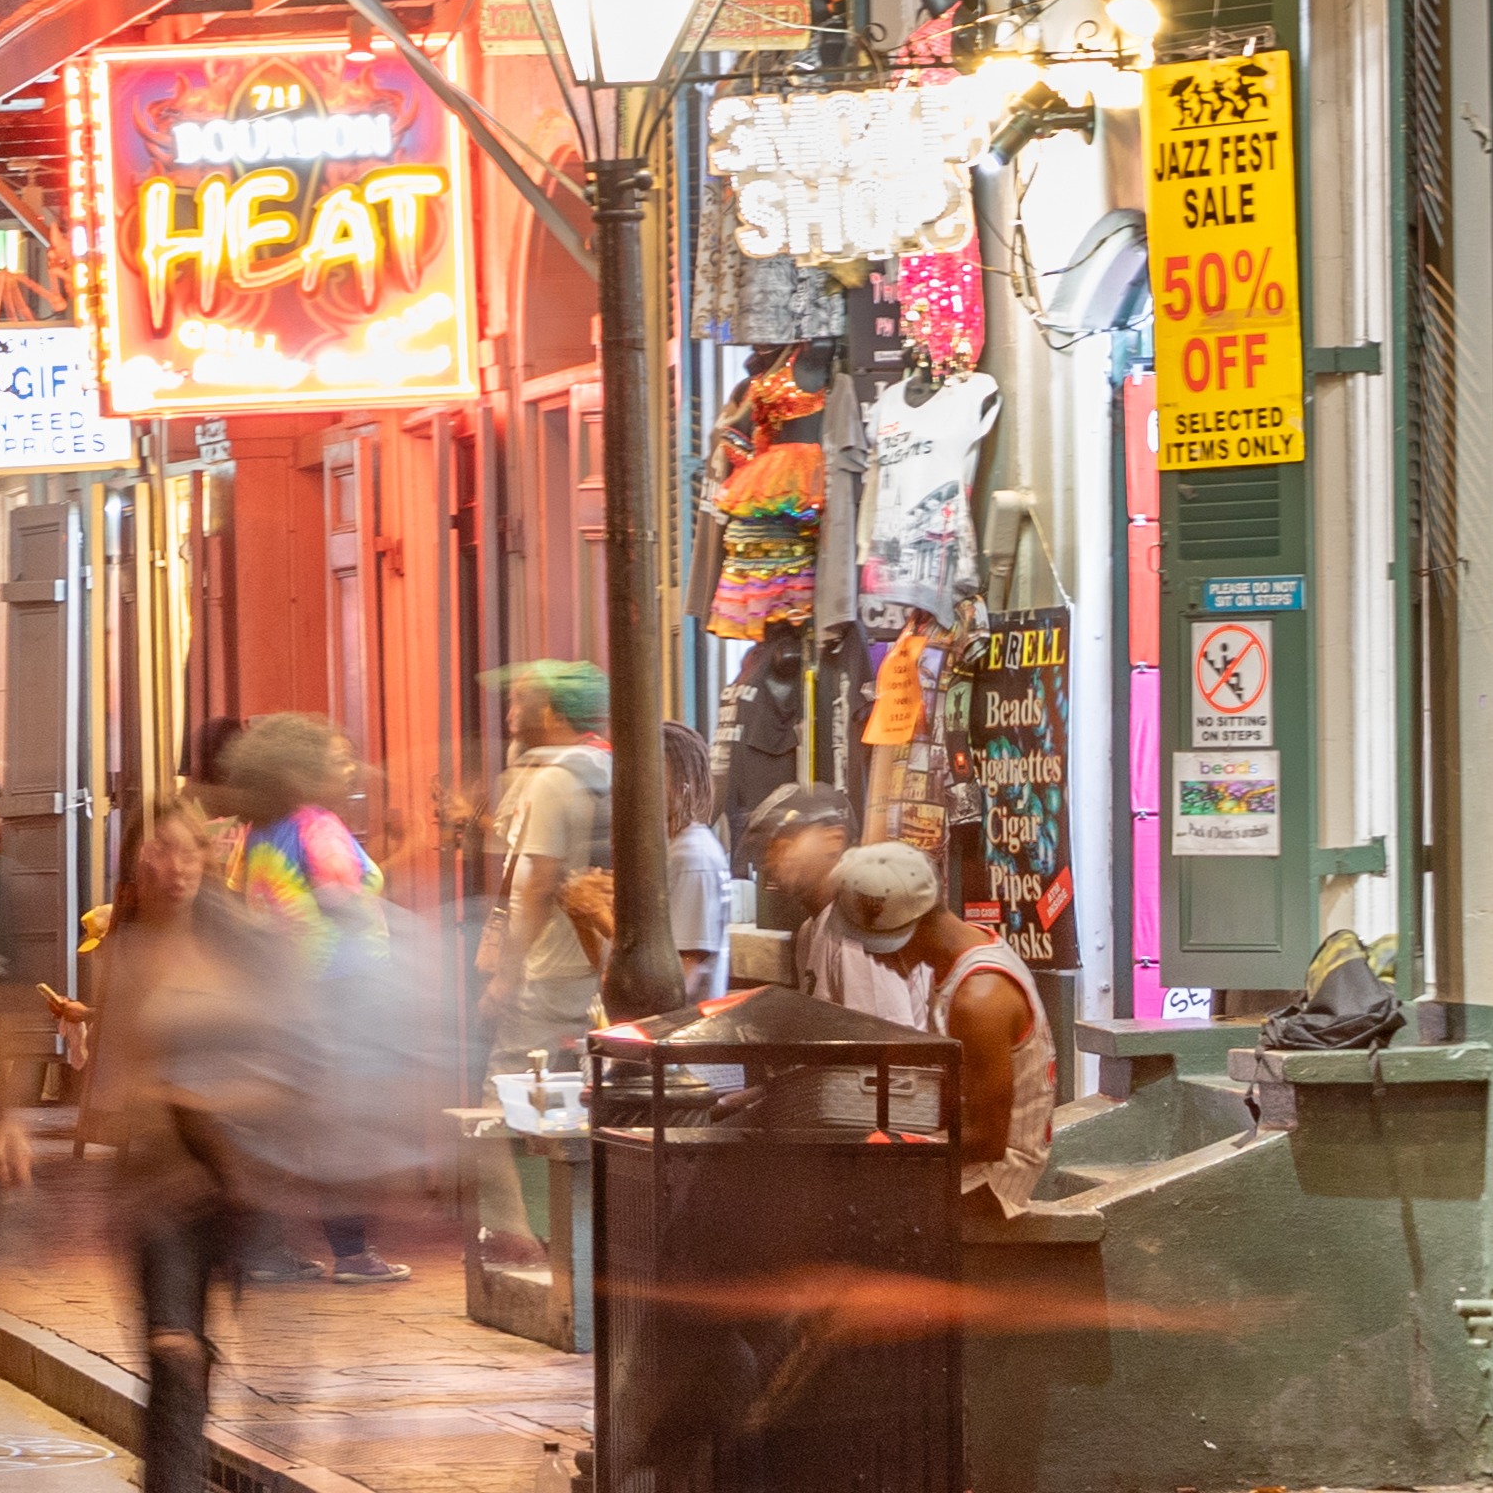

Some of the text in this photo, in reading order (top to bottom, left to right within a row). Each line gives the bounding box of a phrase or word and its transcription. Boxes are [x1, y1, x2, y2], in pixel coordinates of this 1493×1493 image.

[251, 83, 303, 111] 711
[172, 114, 395, 164] BOURBON
[1154, 131, 1279, 182] JAZZ FEST
[1183, 183, 1256, 229] SALE
[141, 165, 449, 340] HEAT
[1162, 246, 1285, 322] 50%
[1182, 332, 1269, 393] OFF
[1174, 406, 1284, 436] SELECTED
[1165, 433, 1296, 465] ITEMS ONLY
[1209, 580, 1298, 595] PLEASE DO NOT
[1215, 593, 1293, 608] SIT ON STEPS
[985, 688, 1043, 729] Beads
[1196, 715, 1267, 729] NO SITTING
[1201, 729, 1262, 742] ON STEPS
[1199, 760, 1260, 776] beads
[986, 806, 1042, 853] Cigar
[990, 865, 1043, 911] Pipes
